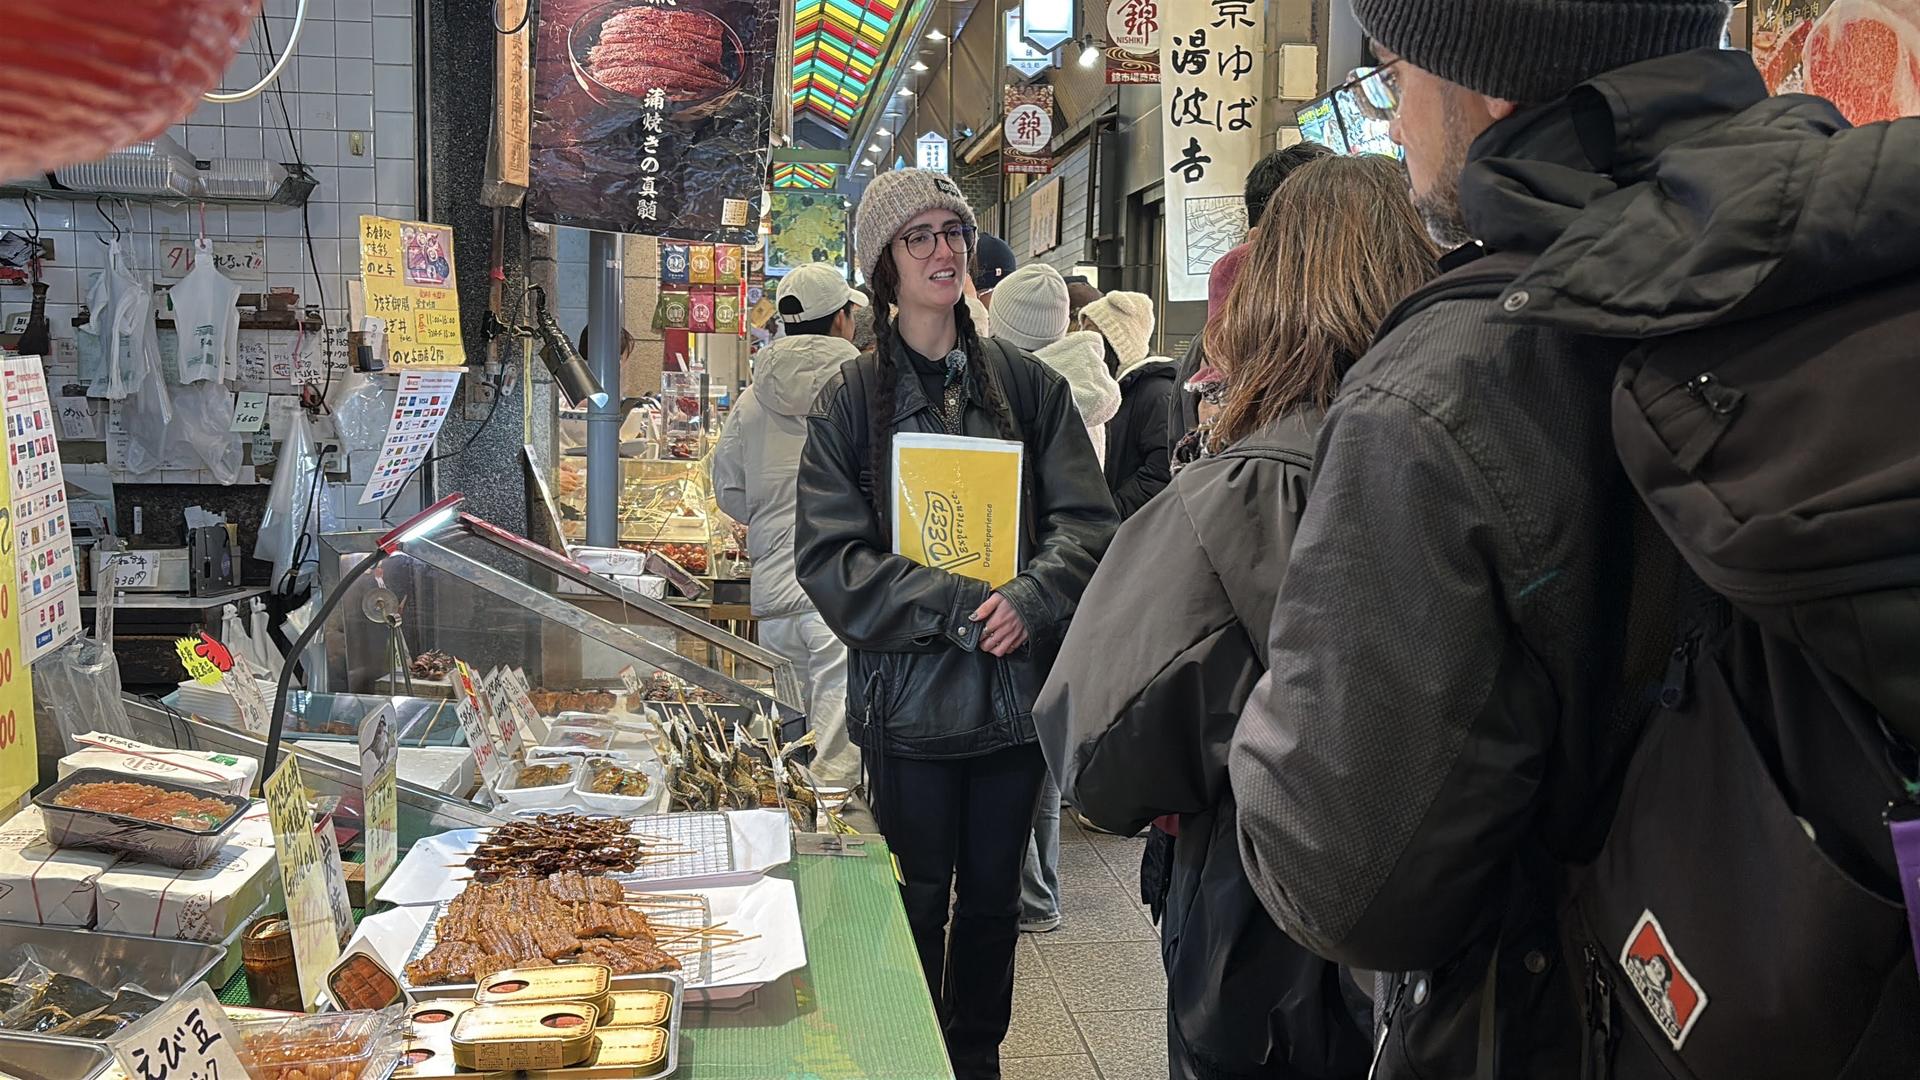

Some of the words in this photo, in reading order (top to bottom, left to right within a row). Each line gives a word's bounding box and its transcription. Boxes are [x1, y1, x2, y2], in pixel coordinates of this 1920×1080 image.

[1116, 36, 1144, 44] NISHIKI
[1111, 72, 1161, 83] 錦市場商店
[1012, 110, 1041, 146] 錦
[1169, 28, 1216, 184] 湯波吉
[636, 87, 667, 221] 蒲焼きの真髄
[983, 503, 994, 568] DeepExperience
[1643, 988, 1681, 1037] DAVIS
